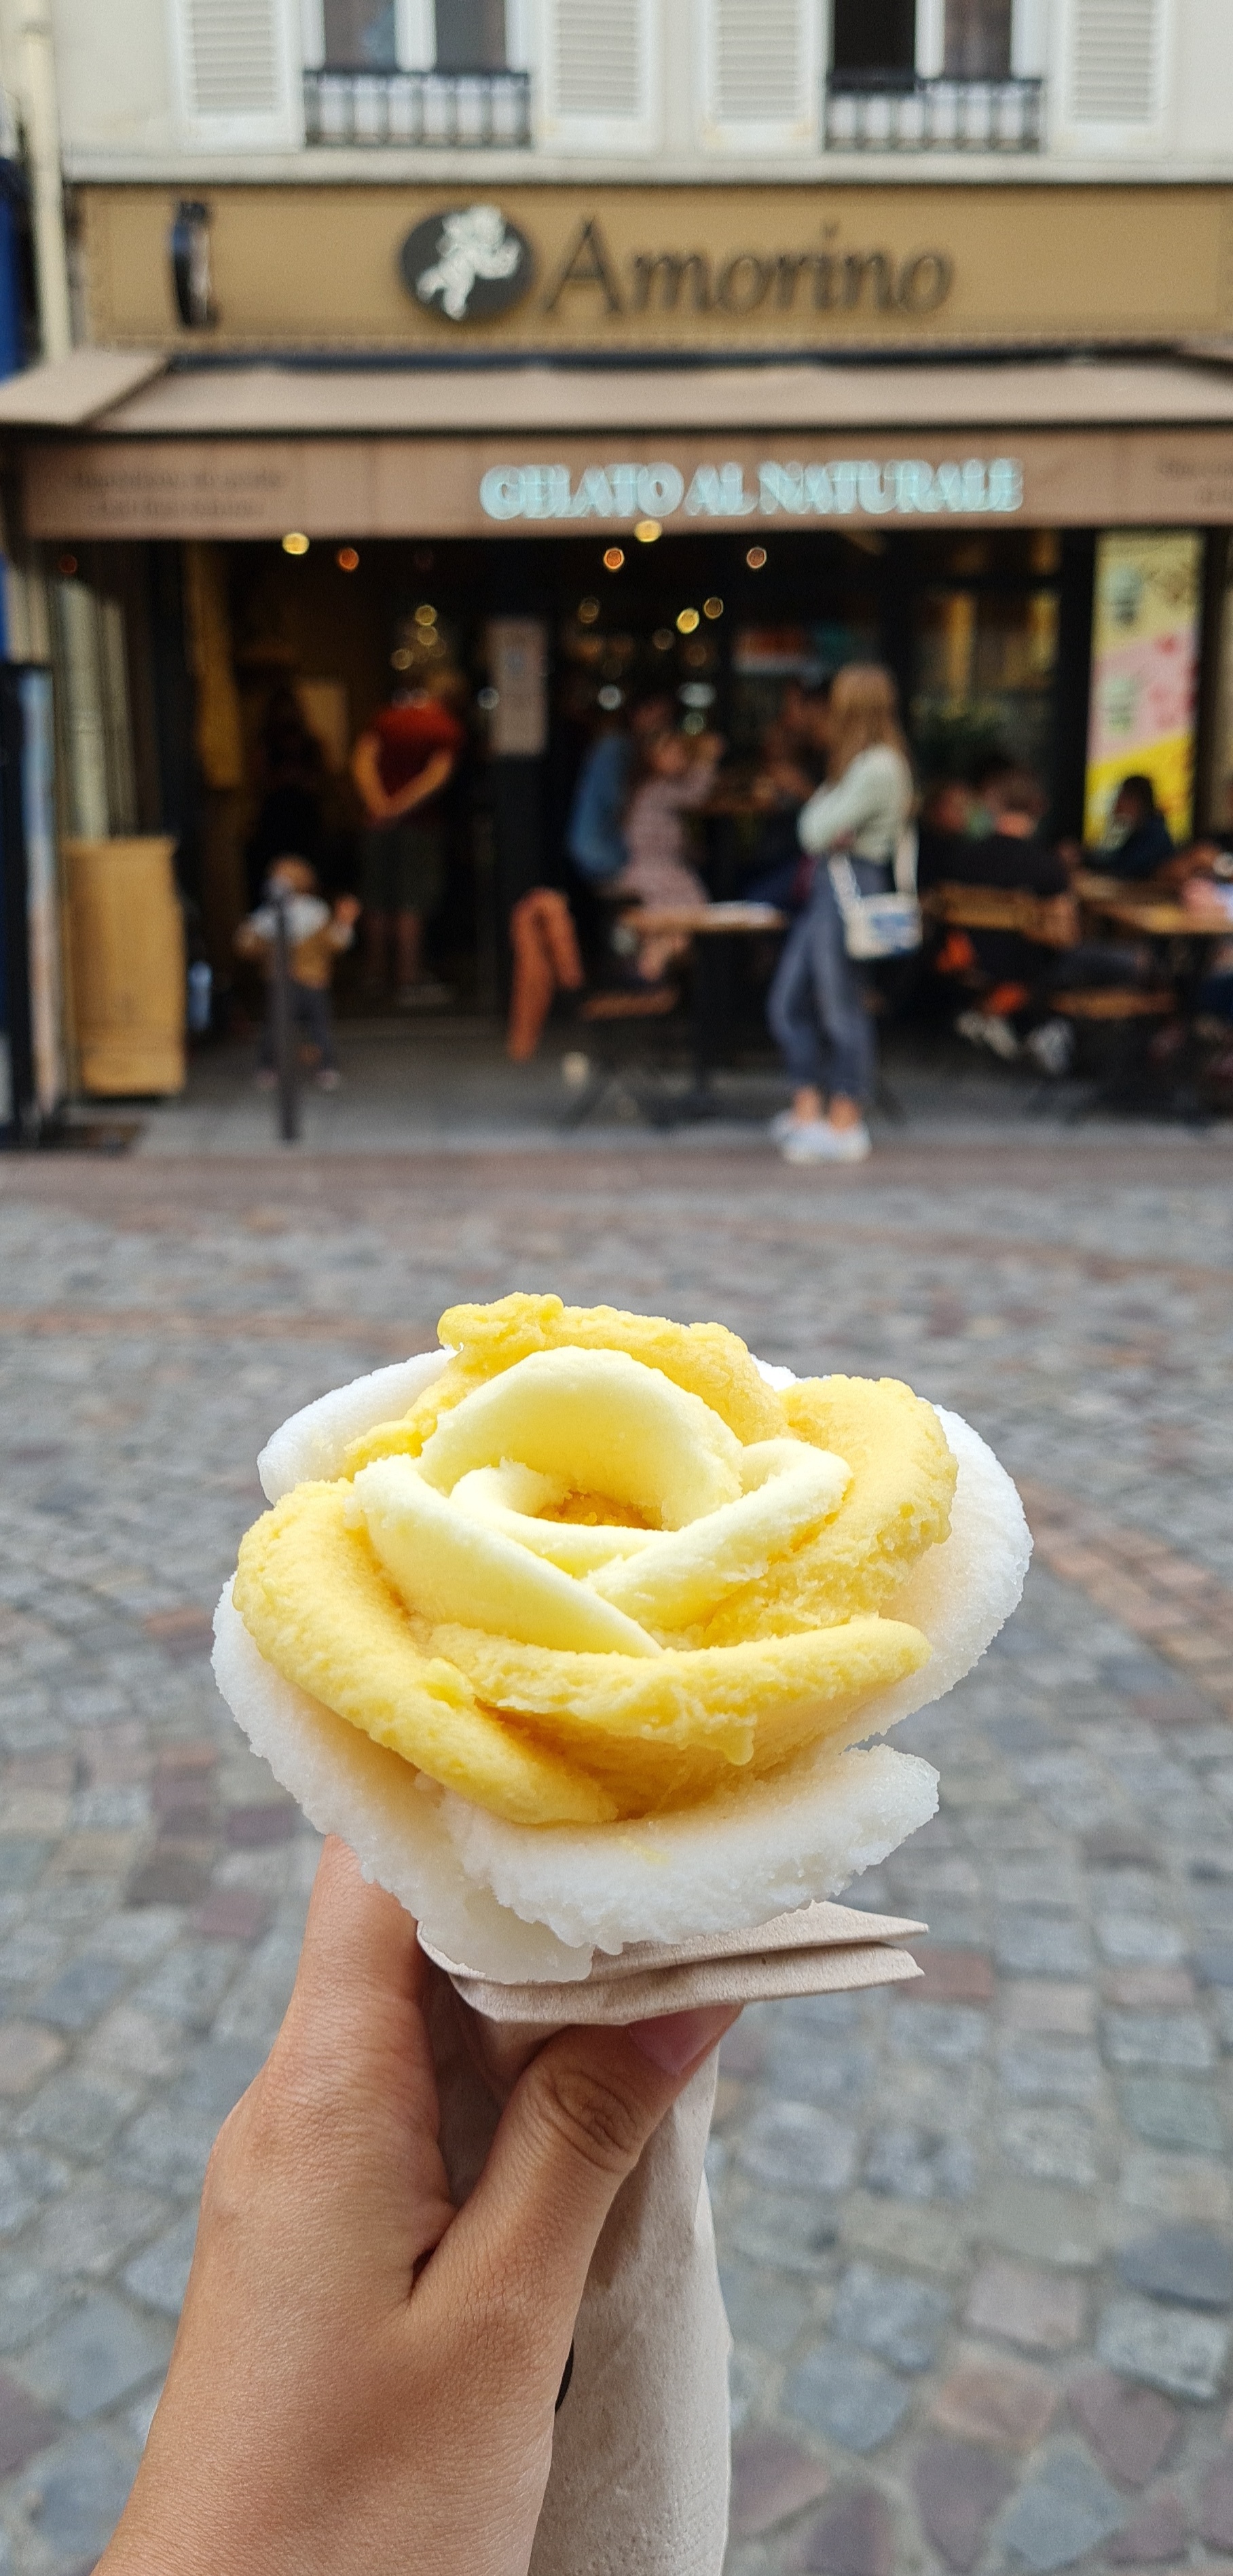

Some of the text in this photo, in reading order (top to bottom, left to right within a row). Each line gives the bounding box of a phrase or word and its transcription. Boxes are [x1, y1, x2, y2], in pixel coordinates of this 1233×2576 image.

[543, 215, 953, 318] Amorino
[479, 458, 1023, 519] GELATO AL NATURALE
